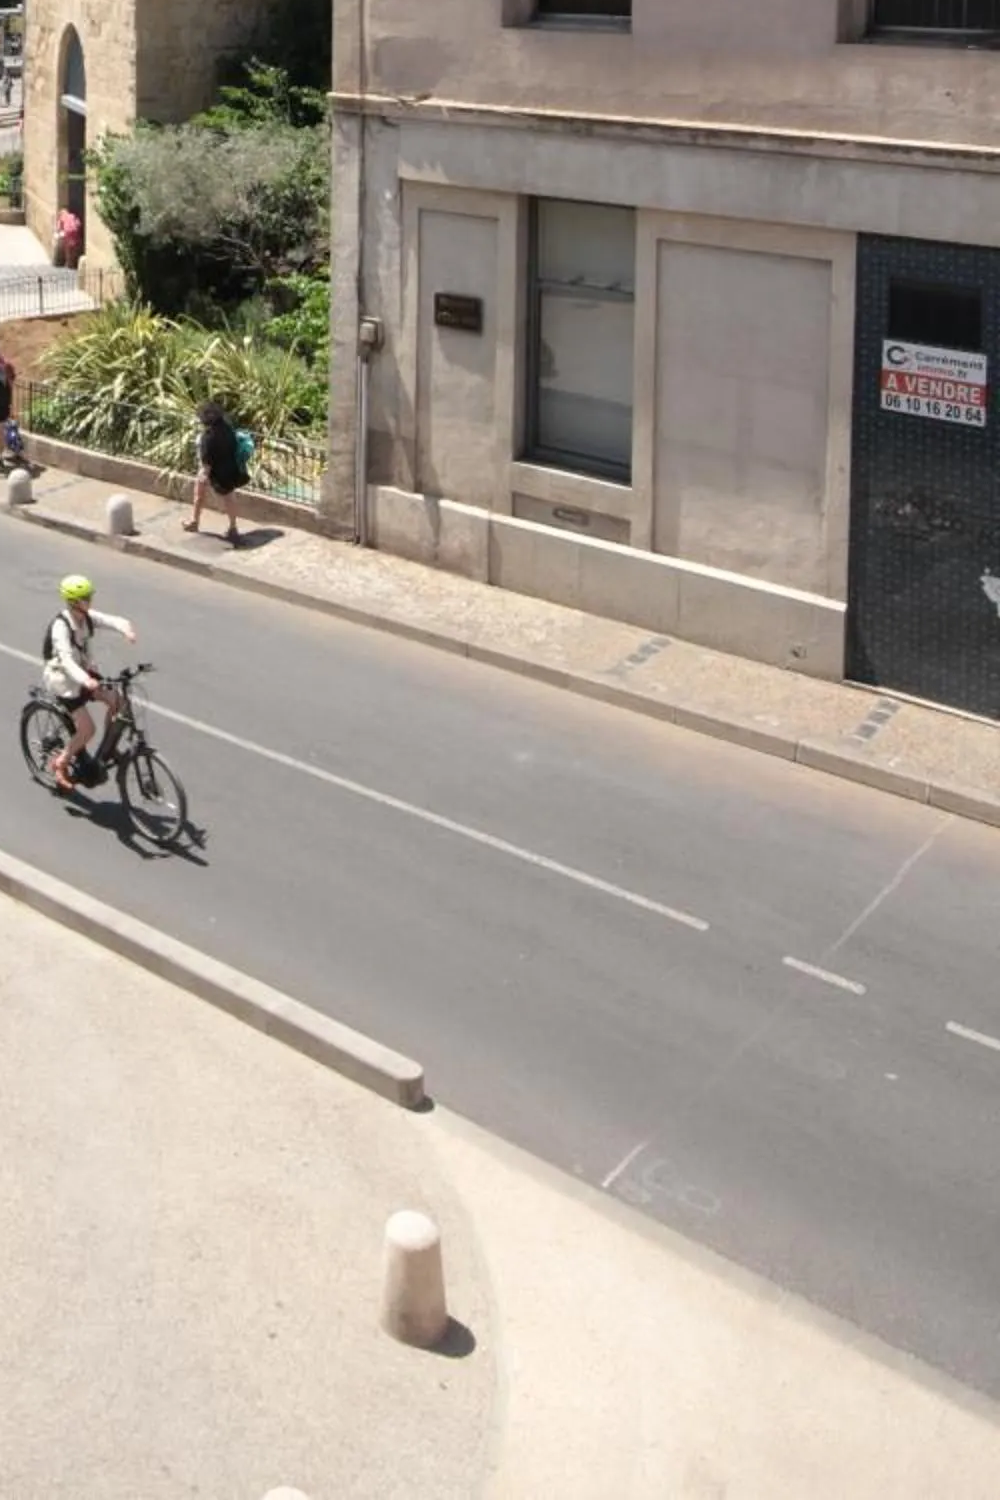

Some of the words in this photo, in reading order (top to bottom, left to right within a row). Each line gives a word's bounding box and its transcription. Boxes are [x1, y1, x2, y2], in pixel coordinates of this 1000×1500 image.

[887, 373, 898, 391] A
[905, 376, 981, 404] VENDRE
[886, 394, 901, 408] 06
[906, 397, 921, 411] 10
[926, 401, 940, 415] 16
[945, 404, 961, 418] 20
[965, 407, 982, 422] 64
